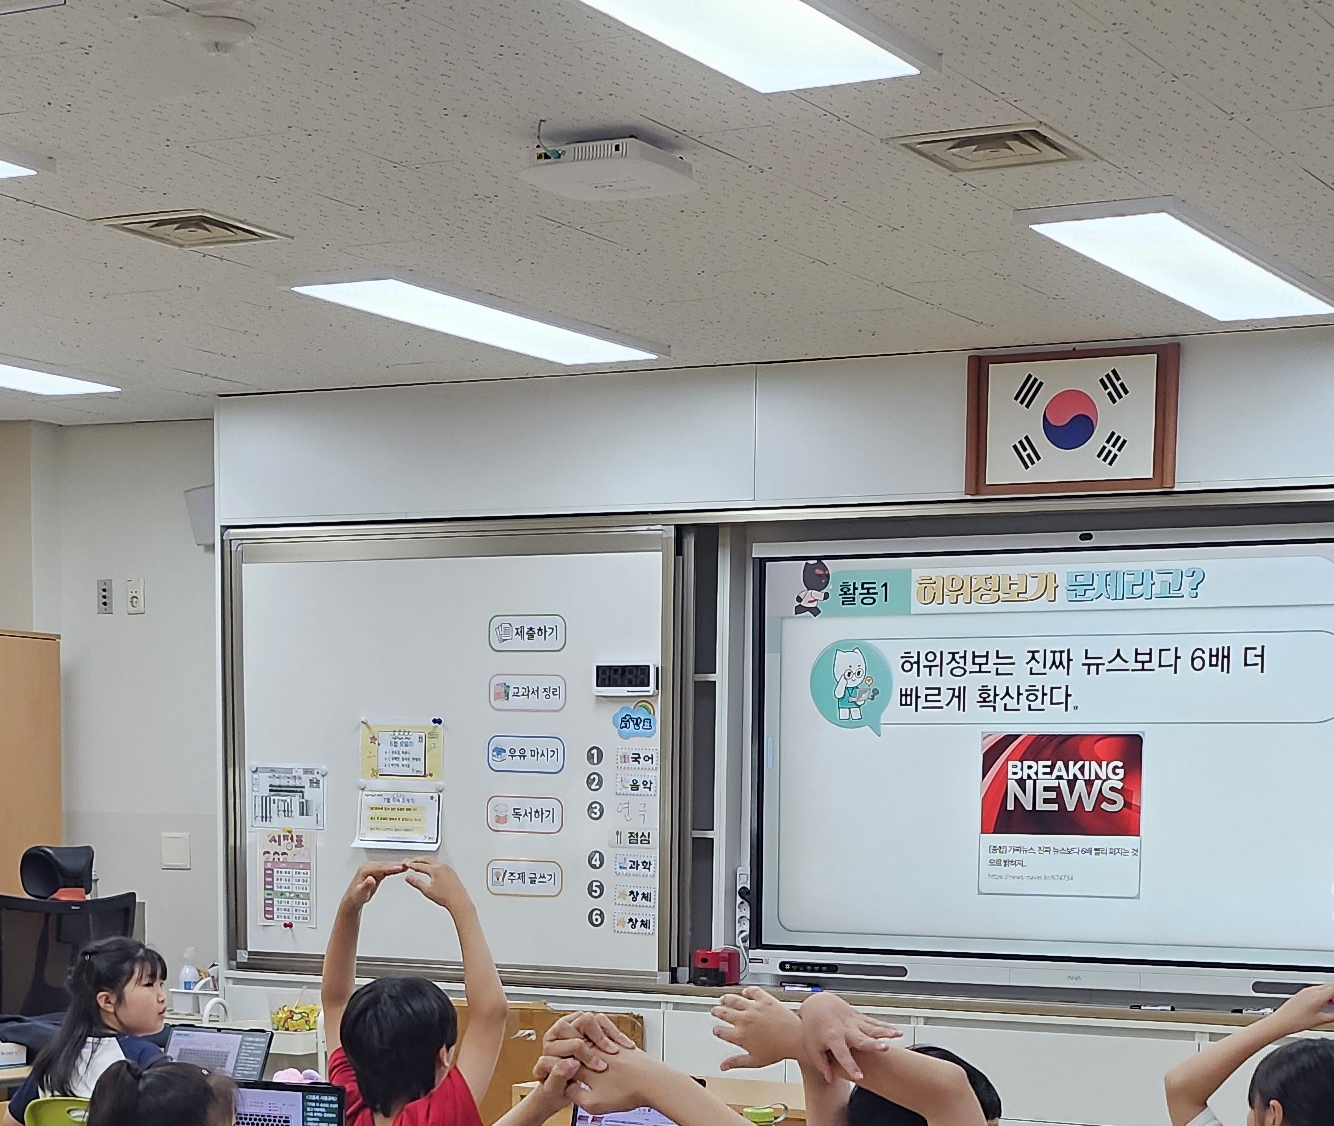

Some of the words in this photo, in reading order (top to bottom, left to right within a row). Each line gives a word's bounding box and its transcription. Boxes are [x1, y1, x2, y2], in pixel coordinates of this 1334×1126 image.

[838, 581, 889, 606] 활동1
[916, 571, 1060, 605] 허위정보가
[1065, 567, 1206, 602] 문제라고?
[514, 624, 558, 642] 제출하기
[899, 649, 1016, 678] 허위정보는
[1025, 648, 1073, 676] 진짜
[1081, 646, 1181, 676] 뉴스보다
[1190, 646, 1231, 674] 6배
[1243, 644, 1266, 674] 더
[511, 685, 540, 700] 교과서
[899, 685, 967, 712] 빠르게
[976, 684, 1079, 712] 확산한다.
[620, 714, 652, 730] 시간표
[507, 747, 527, 762] 우유
[530, 747, 559, 763] 마시기
[630, 752, 654, 765] 국어
[1007, 760, 1125, 780] BREAKING
[629, 779, 653, 792] 음악
[1006, 779, 1125, 812] NEWS
[511, 807, 556, 824] 독서하기
[627, 831, 651, 845] 점심
[628, 859, 653, 873] 과학
[507, 871, 526, 885] 주제
[528, 871, 556, 886] 글쓰기
